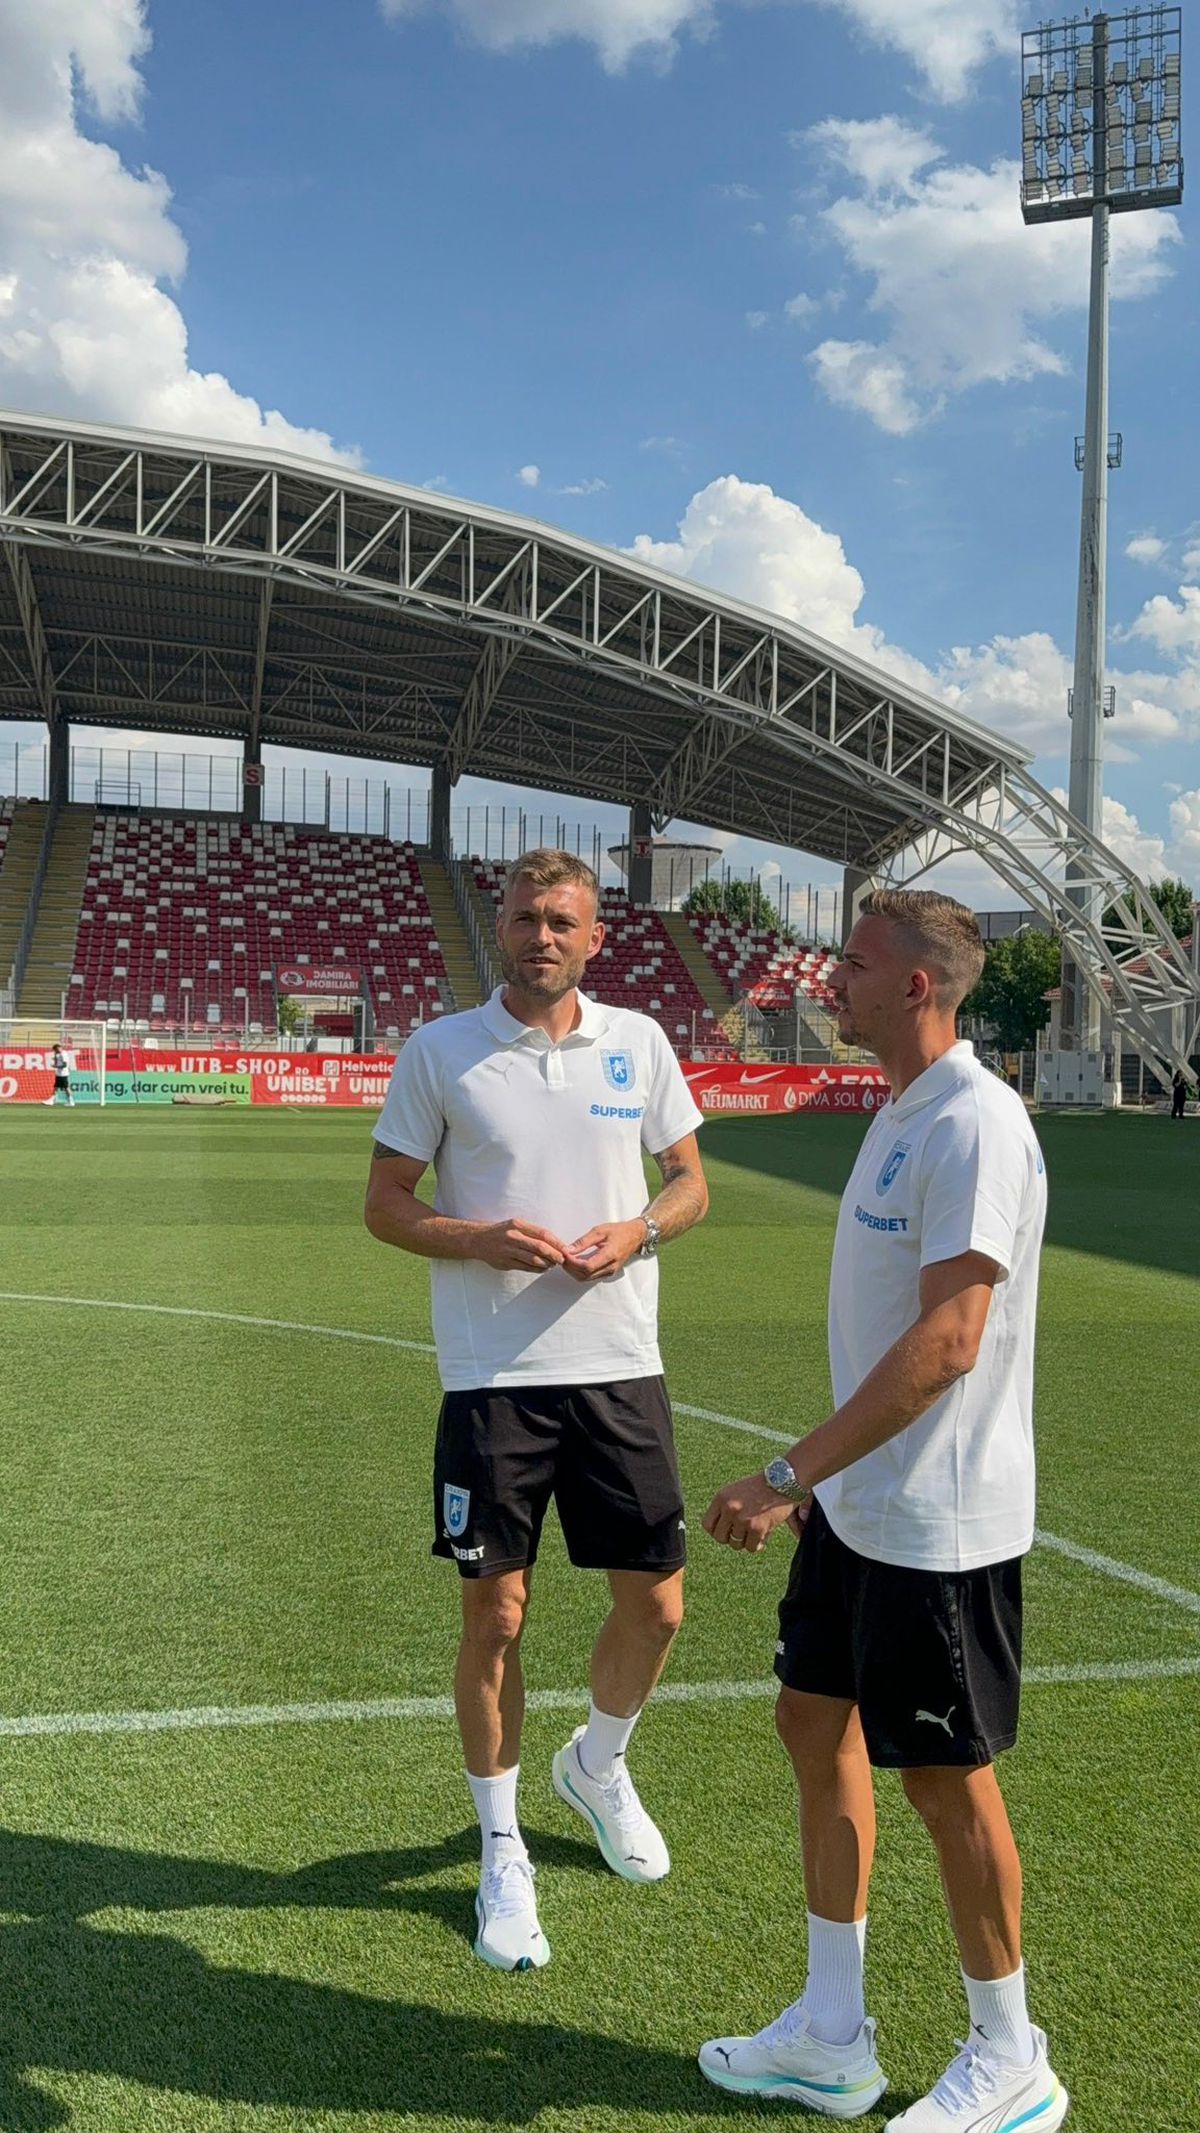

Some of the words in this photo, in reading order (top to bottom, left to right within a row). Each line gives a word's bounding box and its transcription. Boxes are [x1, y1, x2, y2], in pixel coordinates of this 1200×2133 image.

[246, 768, 260, 785] S
[313, 970, 352, 980] DAMIRA
[305, 981, 359, 990] IMOBILIARI
[131, 1081, 158, 1094] dar
[157, 1083, 196, 1094] cum
[198, 1082, 227, 1095] vrei
[230, 1083, 249, 1095] tu.
[267, 1076, 340, 1093] UNIBET
[699, 1084, 769, 1110] NEUMARKT
[798, 1092, 830, 1106] DIVA
[834, 1092, 858, 1107] SOL
[854, 1204, 909, 1232] SUPERBET
[450, 1542, 485, 1561] RBET
